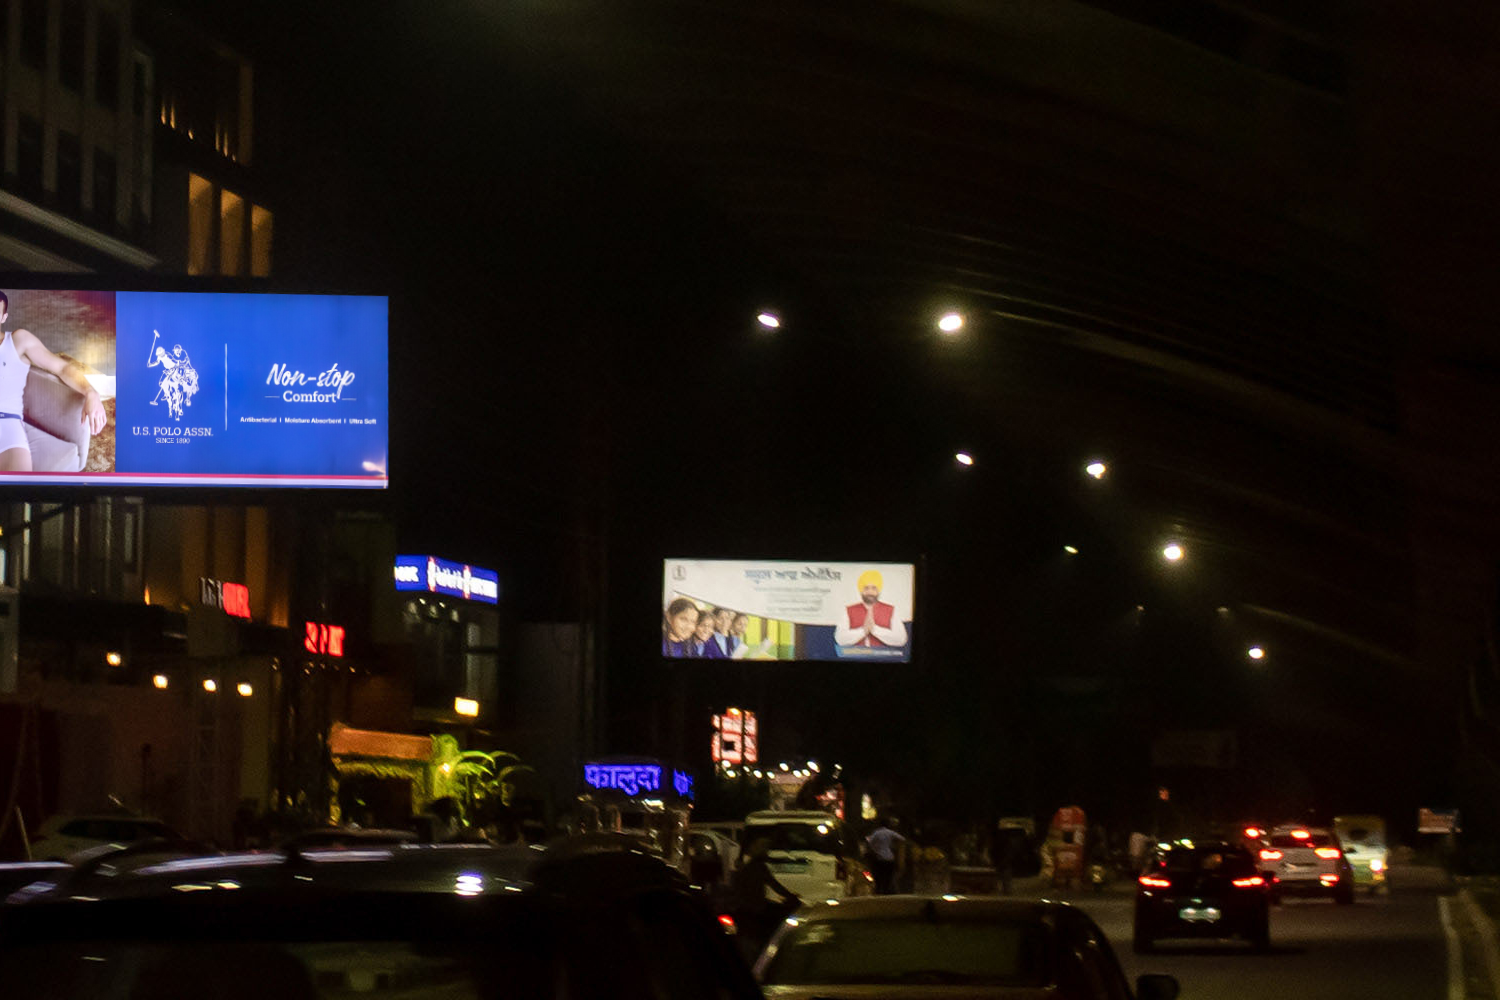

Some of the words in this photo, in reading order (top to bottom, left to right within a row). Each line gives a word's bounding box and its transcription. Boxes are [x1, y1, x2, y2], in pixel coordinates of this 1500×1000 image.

[265, 362, 356, 400] Non-stop
[282, 390, 337, 403] Comfort
[132, 426, 151, 436] U.S.
[153, 426, 182, 436] POLO
